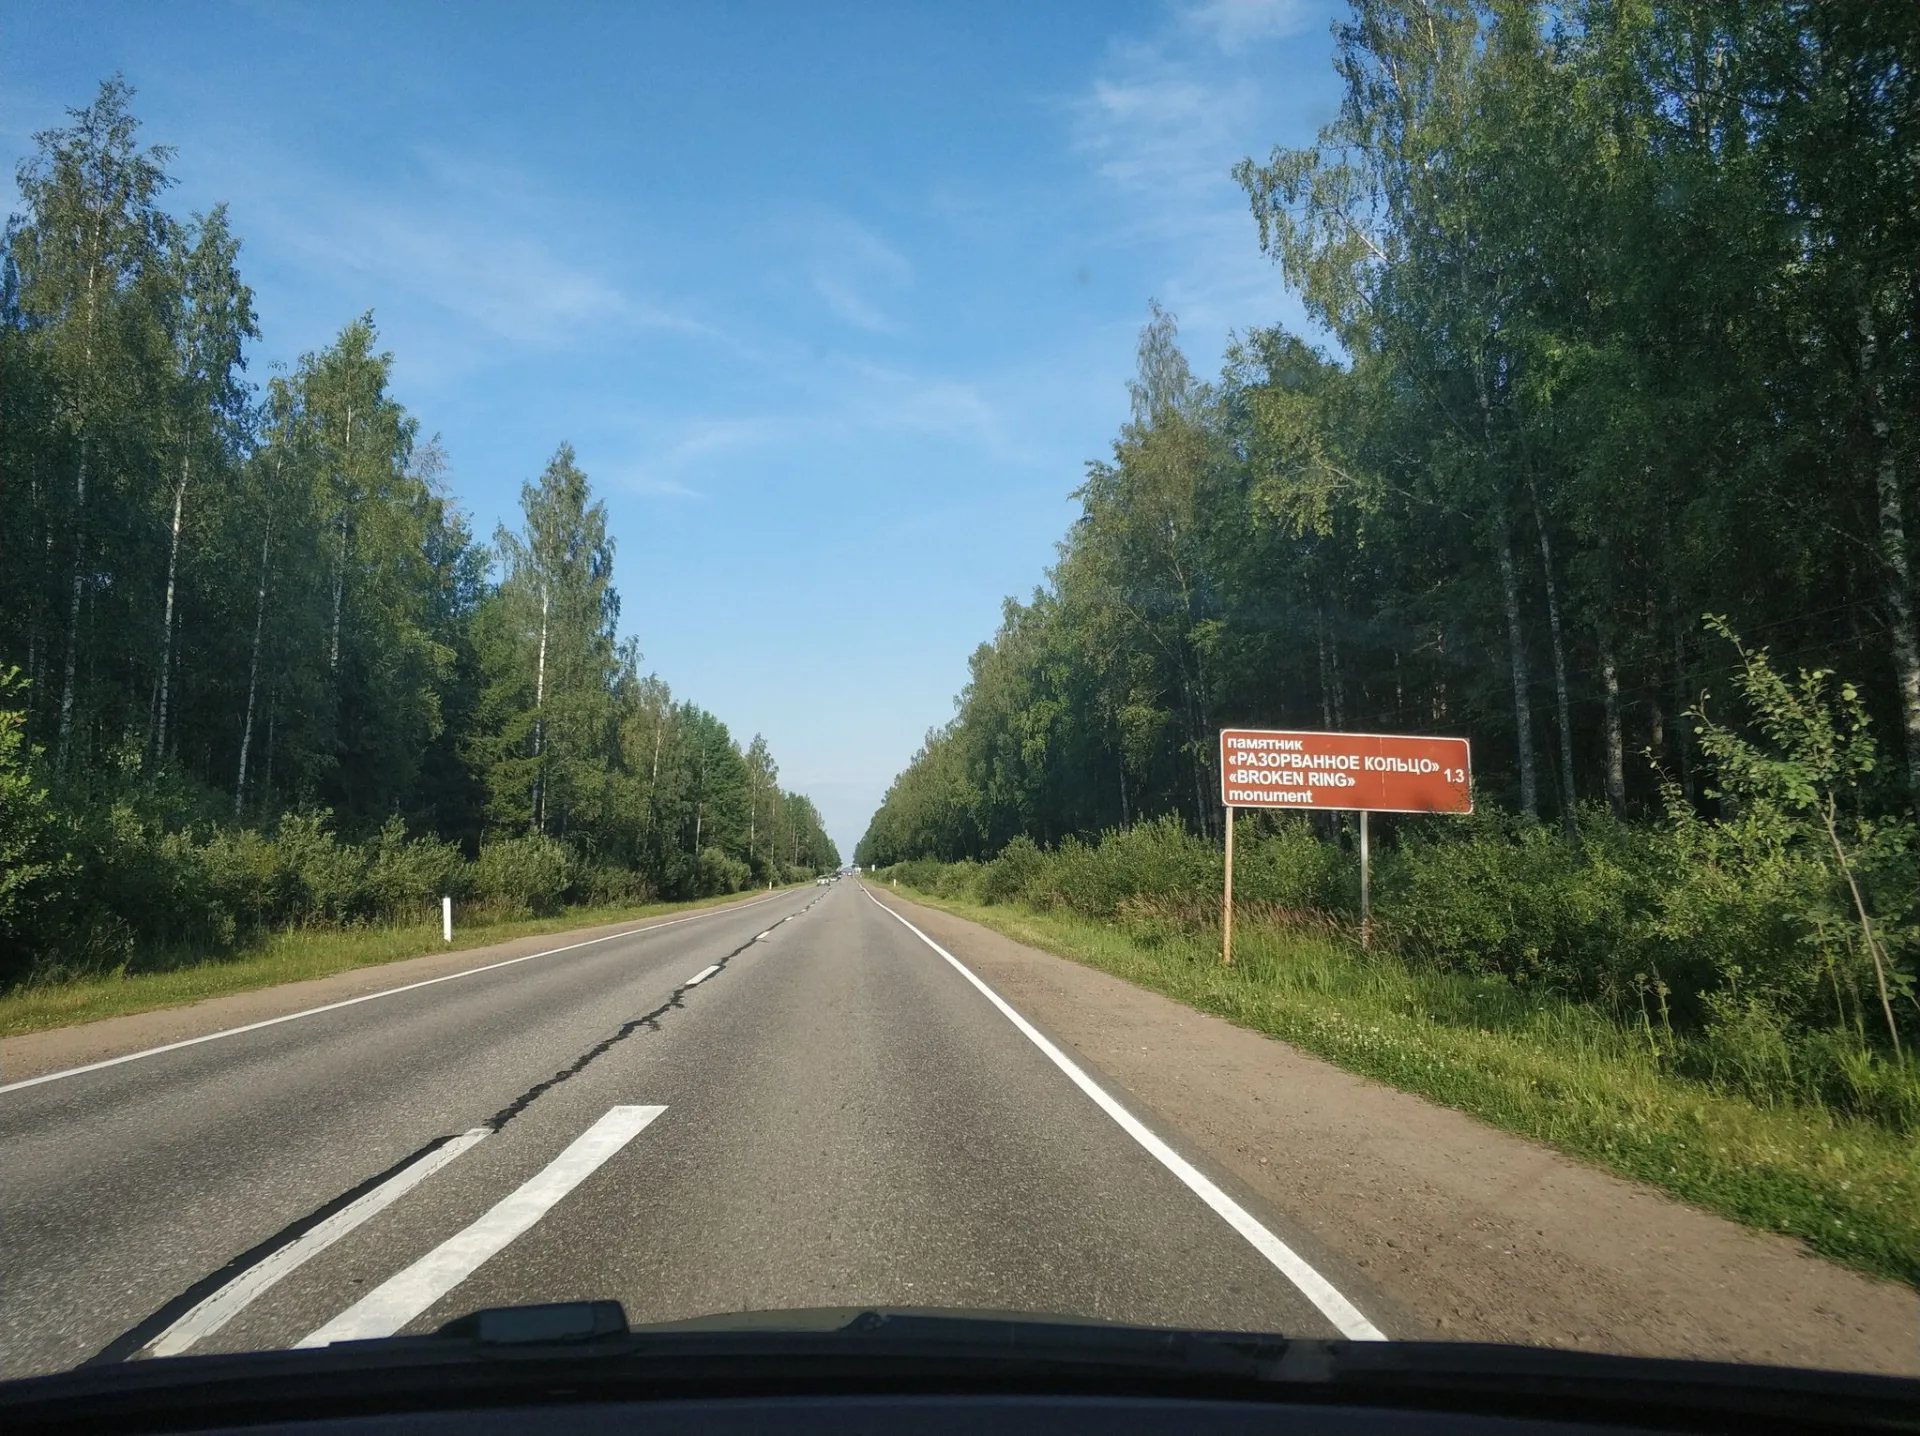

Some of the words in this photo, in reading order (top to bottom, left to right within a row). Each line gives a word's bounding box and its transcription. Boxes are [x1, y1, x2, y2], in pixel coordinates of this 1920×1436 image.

[1227, 737, 1303, 751] памятник
[1228, 752, 1360, 770] «РАЗОРВАННОЕ
[1365, 756, 1440, 775] КОЛЬЦО»
[1229, 769, 1304, 786] «BROKEN
[1308, 772, 1356, 787] RING»
[1444, 768, 1465, 783] 1.3
[1229, 789, 1313, 803] monument
